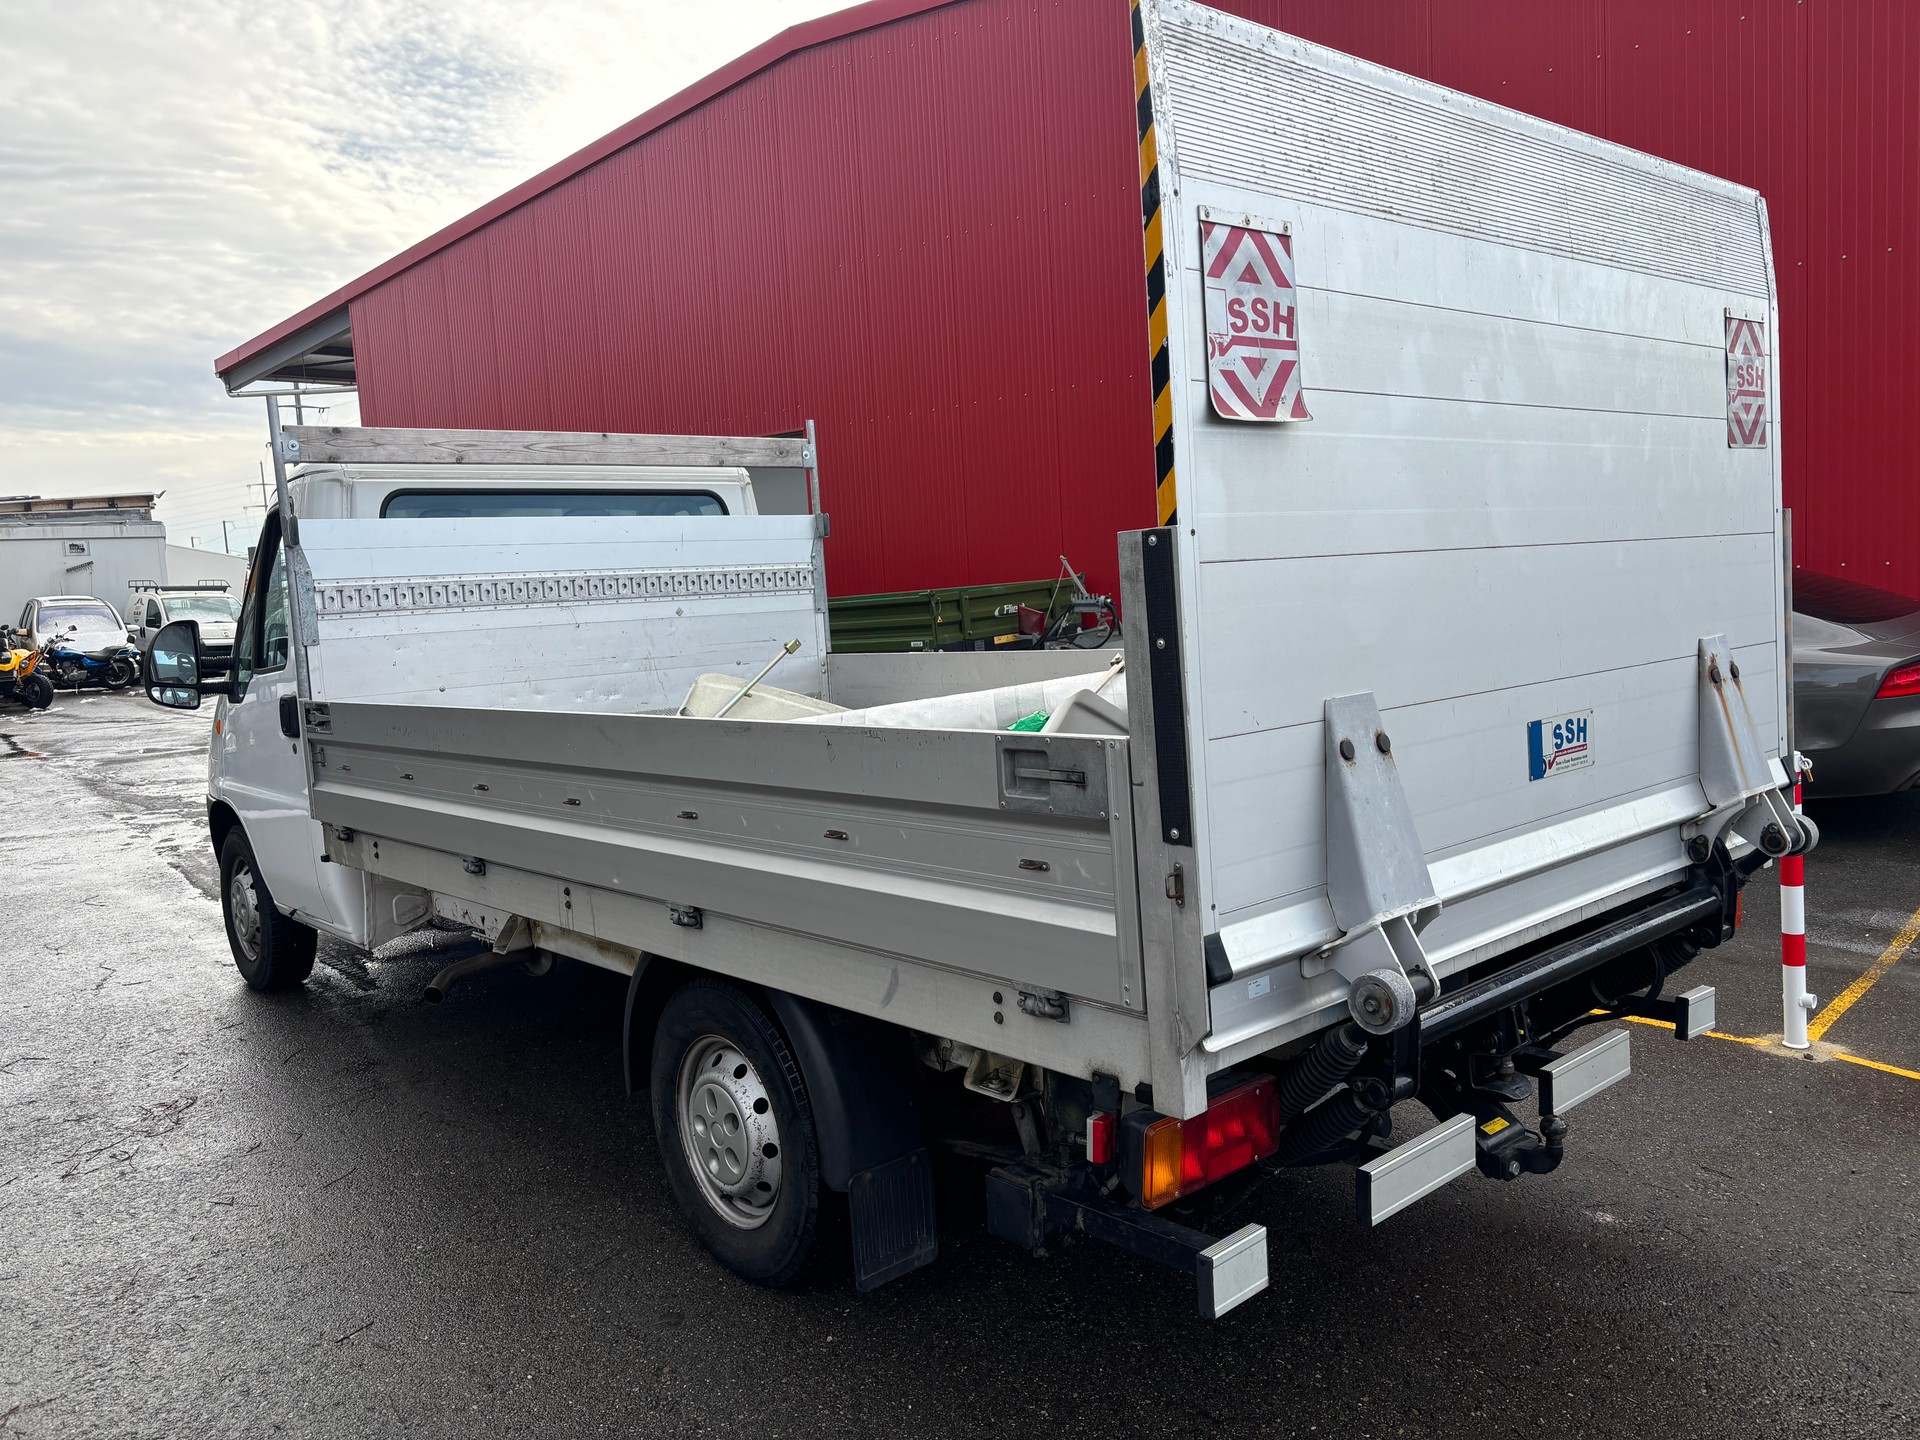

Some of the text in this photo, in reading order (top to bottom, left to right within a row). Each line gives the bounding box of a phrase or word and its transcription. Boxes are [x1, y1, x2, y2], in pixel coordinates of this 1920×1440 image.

[1228, 297, 1295, 339] SSH
[1736, 364, 1765, 390] SSH
[1003, 603, 1025, 615] Flie
[1553, 717, 1588, 750] SSH
